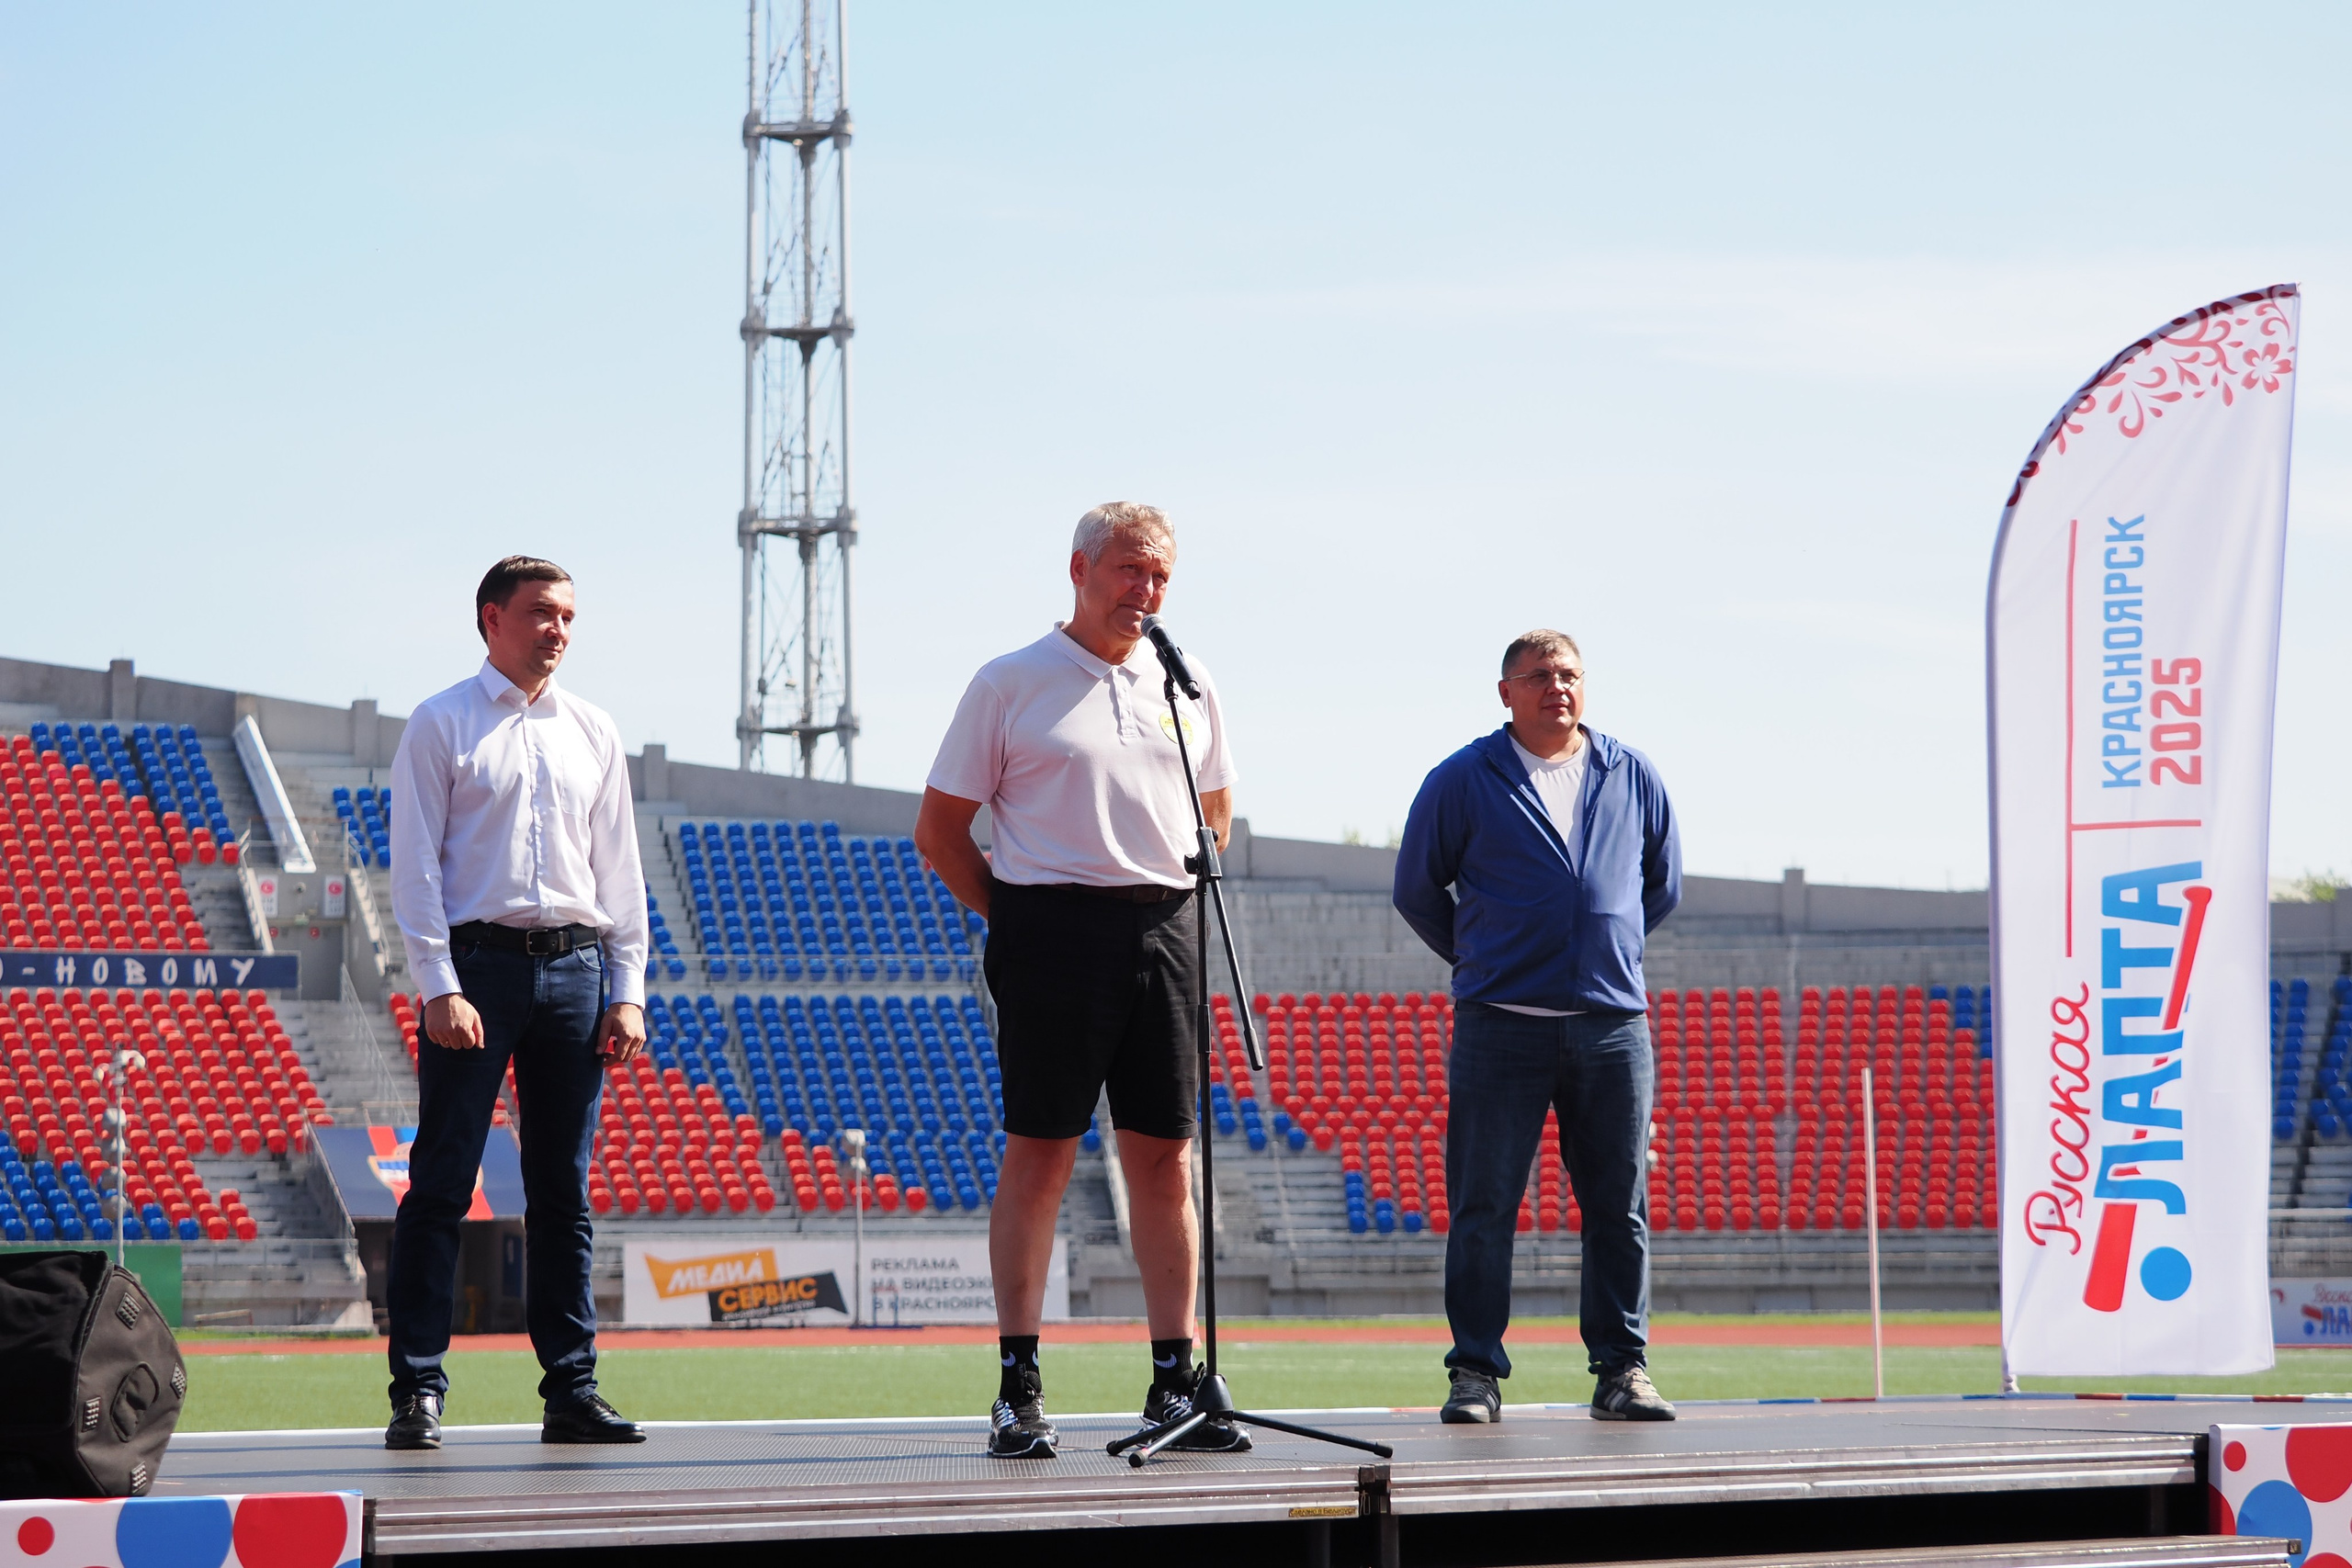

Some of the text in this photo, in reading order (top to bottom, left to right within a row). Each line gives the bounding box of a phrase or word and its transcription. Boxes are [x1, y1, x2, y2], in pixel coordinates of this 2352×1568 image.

[2102, 513, 2145, 788] КРАСНОЯРСК
[2149, 657, 2201, 785] 2025
[0, 956, 255, 987] -НОВОМУ
[2093, 860, 2202, 1215] ЛАПТА
[2023, 981, 2090, 1256] Русская
[666, 1258, 764, 1293] МЕДИА
[872, 1257, 960, 1270] РЕКЛАМА
[718, 1277, 819, 1313] СЕРВИС
[888, 1295, 996, 1311] КРАСНОЯРС
[2320, 1305, 2352, 1336] ЛА
